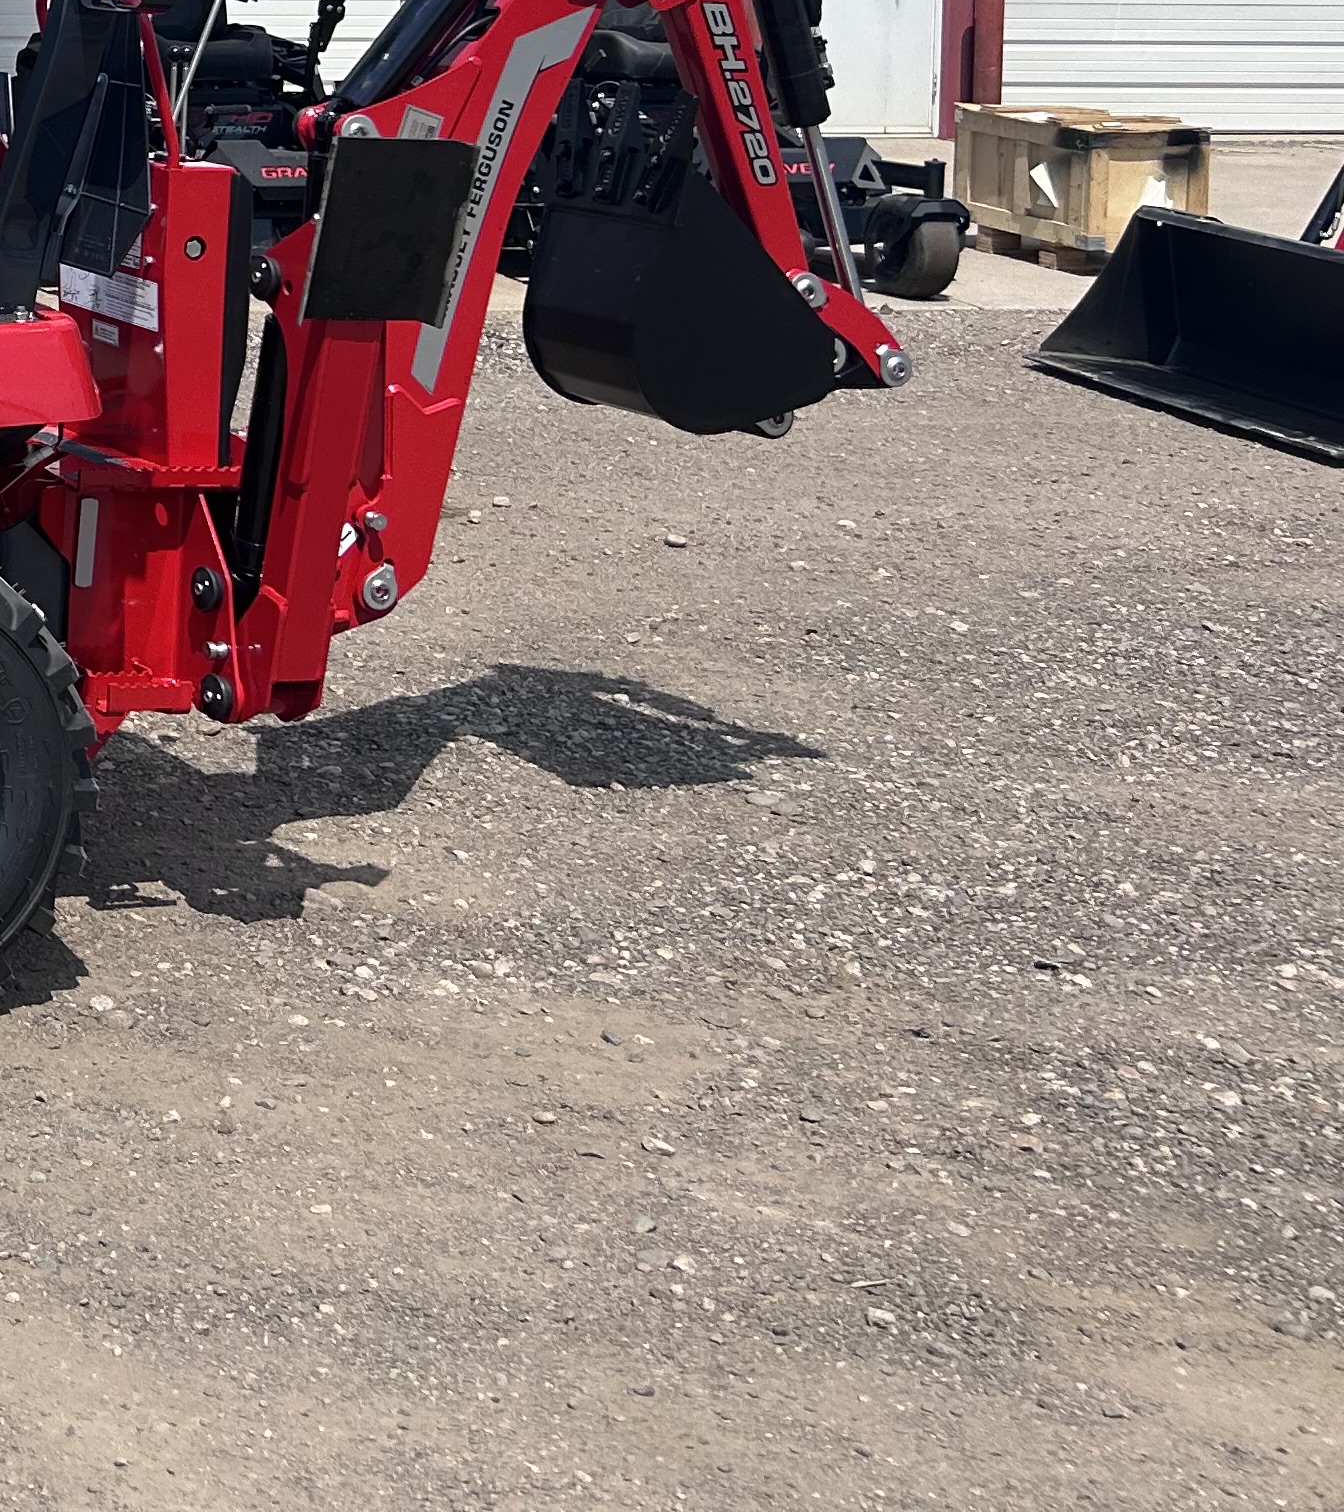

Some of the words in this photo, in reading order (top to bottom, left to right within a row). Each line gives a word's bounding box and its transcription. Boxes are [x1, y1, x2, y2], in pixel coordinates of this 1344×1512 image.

[212, 125, 268, 134] STEALTH
[702, 2, 777, 185] BH.2720
[467, 99, 515, 219] FERGUSON
